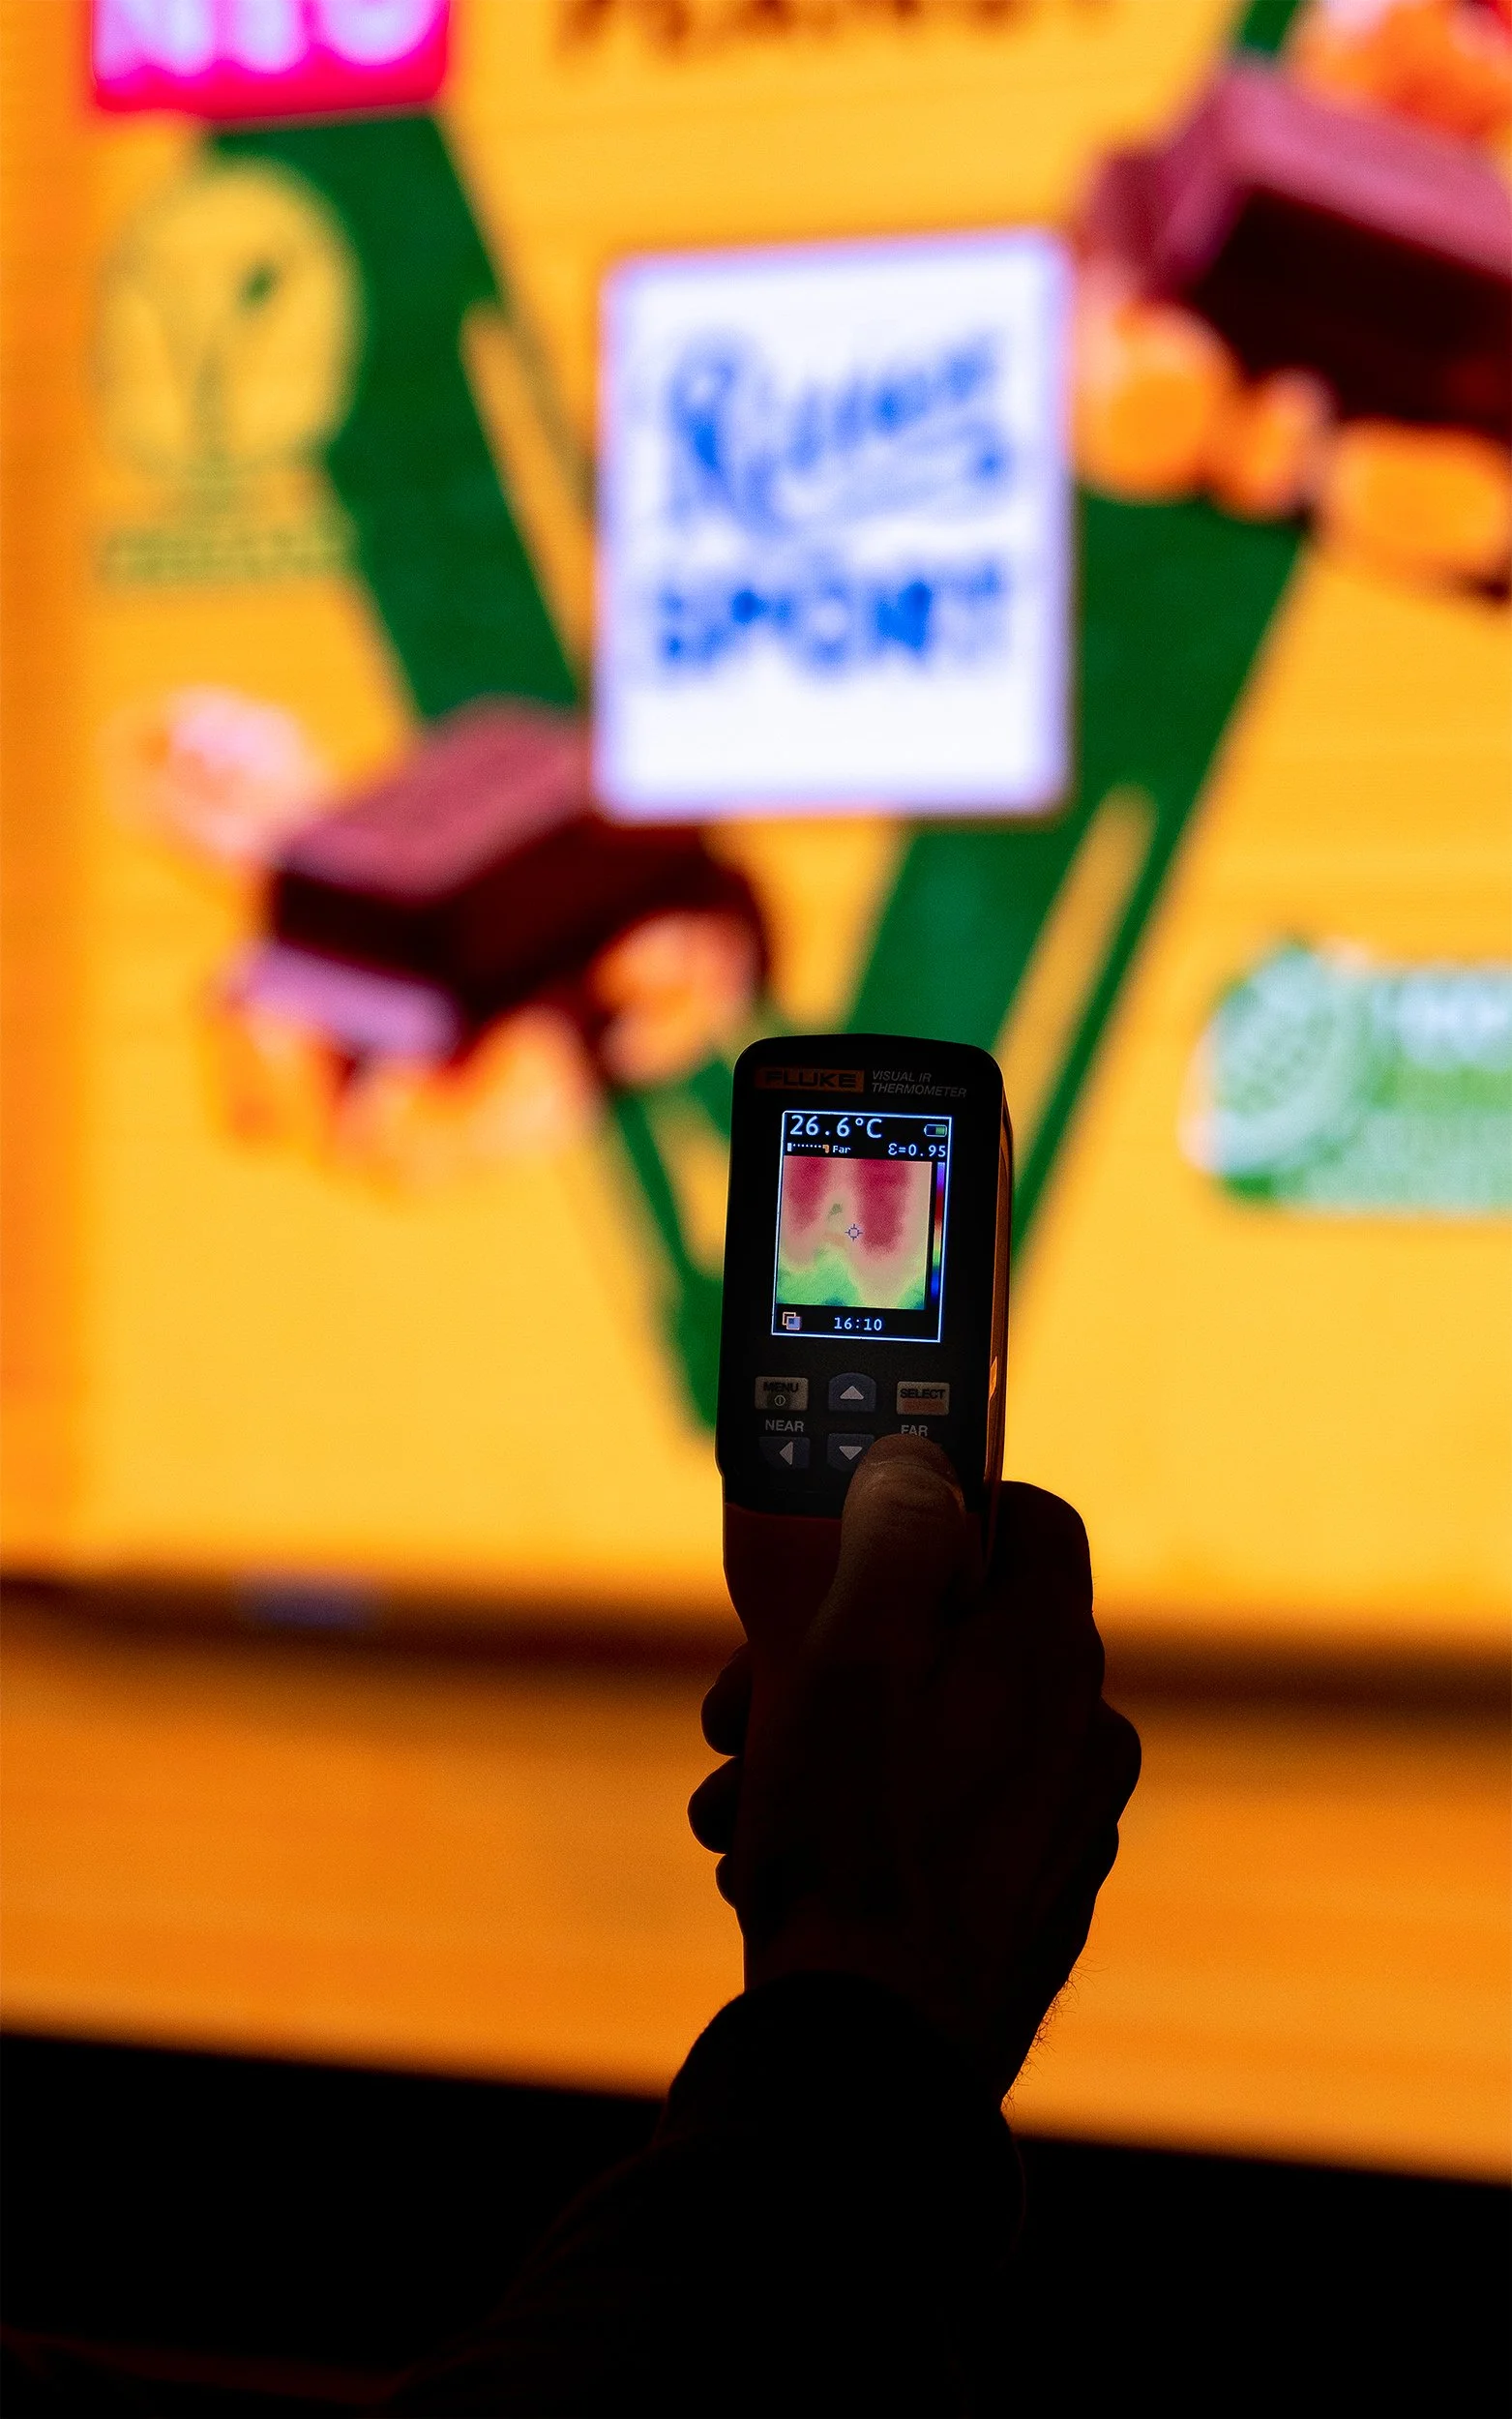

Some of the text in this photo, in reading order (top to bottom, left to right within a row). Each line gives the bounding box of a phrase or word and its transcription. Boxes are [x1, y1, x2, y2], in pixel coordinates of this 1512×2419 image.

[765, 1069, 857, 1089] FLUKE
[872, 1070, 933, 1084] VISUAL IR
[872, 1082, 967, 1099] THERMOMETER
[789, 1115, 883, 1139] 26.6°C
[832, 1145, 851, 1154] Far
[833, 1316, 883, 1332] 16:10
[763, 1381, 800, 1394] MENU
[900, 1388, 946, 1400] SELECT
[764, 1419, 805, 1433] NEAR
[901, 1424, 930, 1438] FAR
